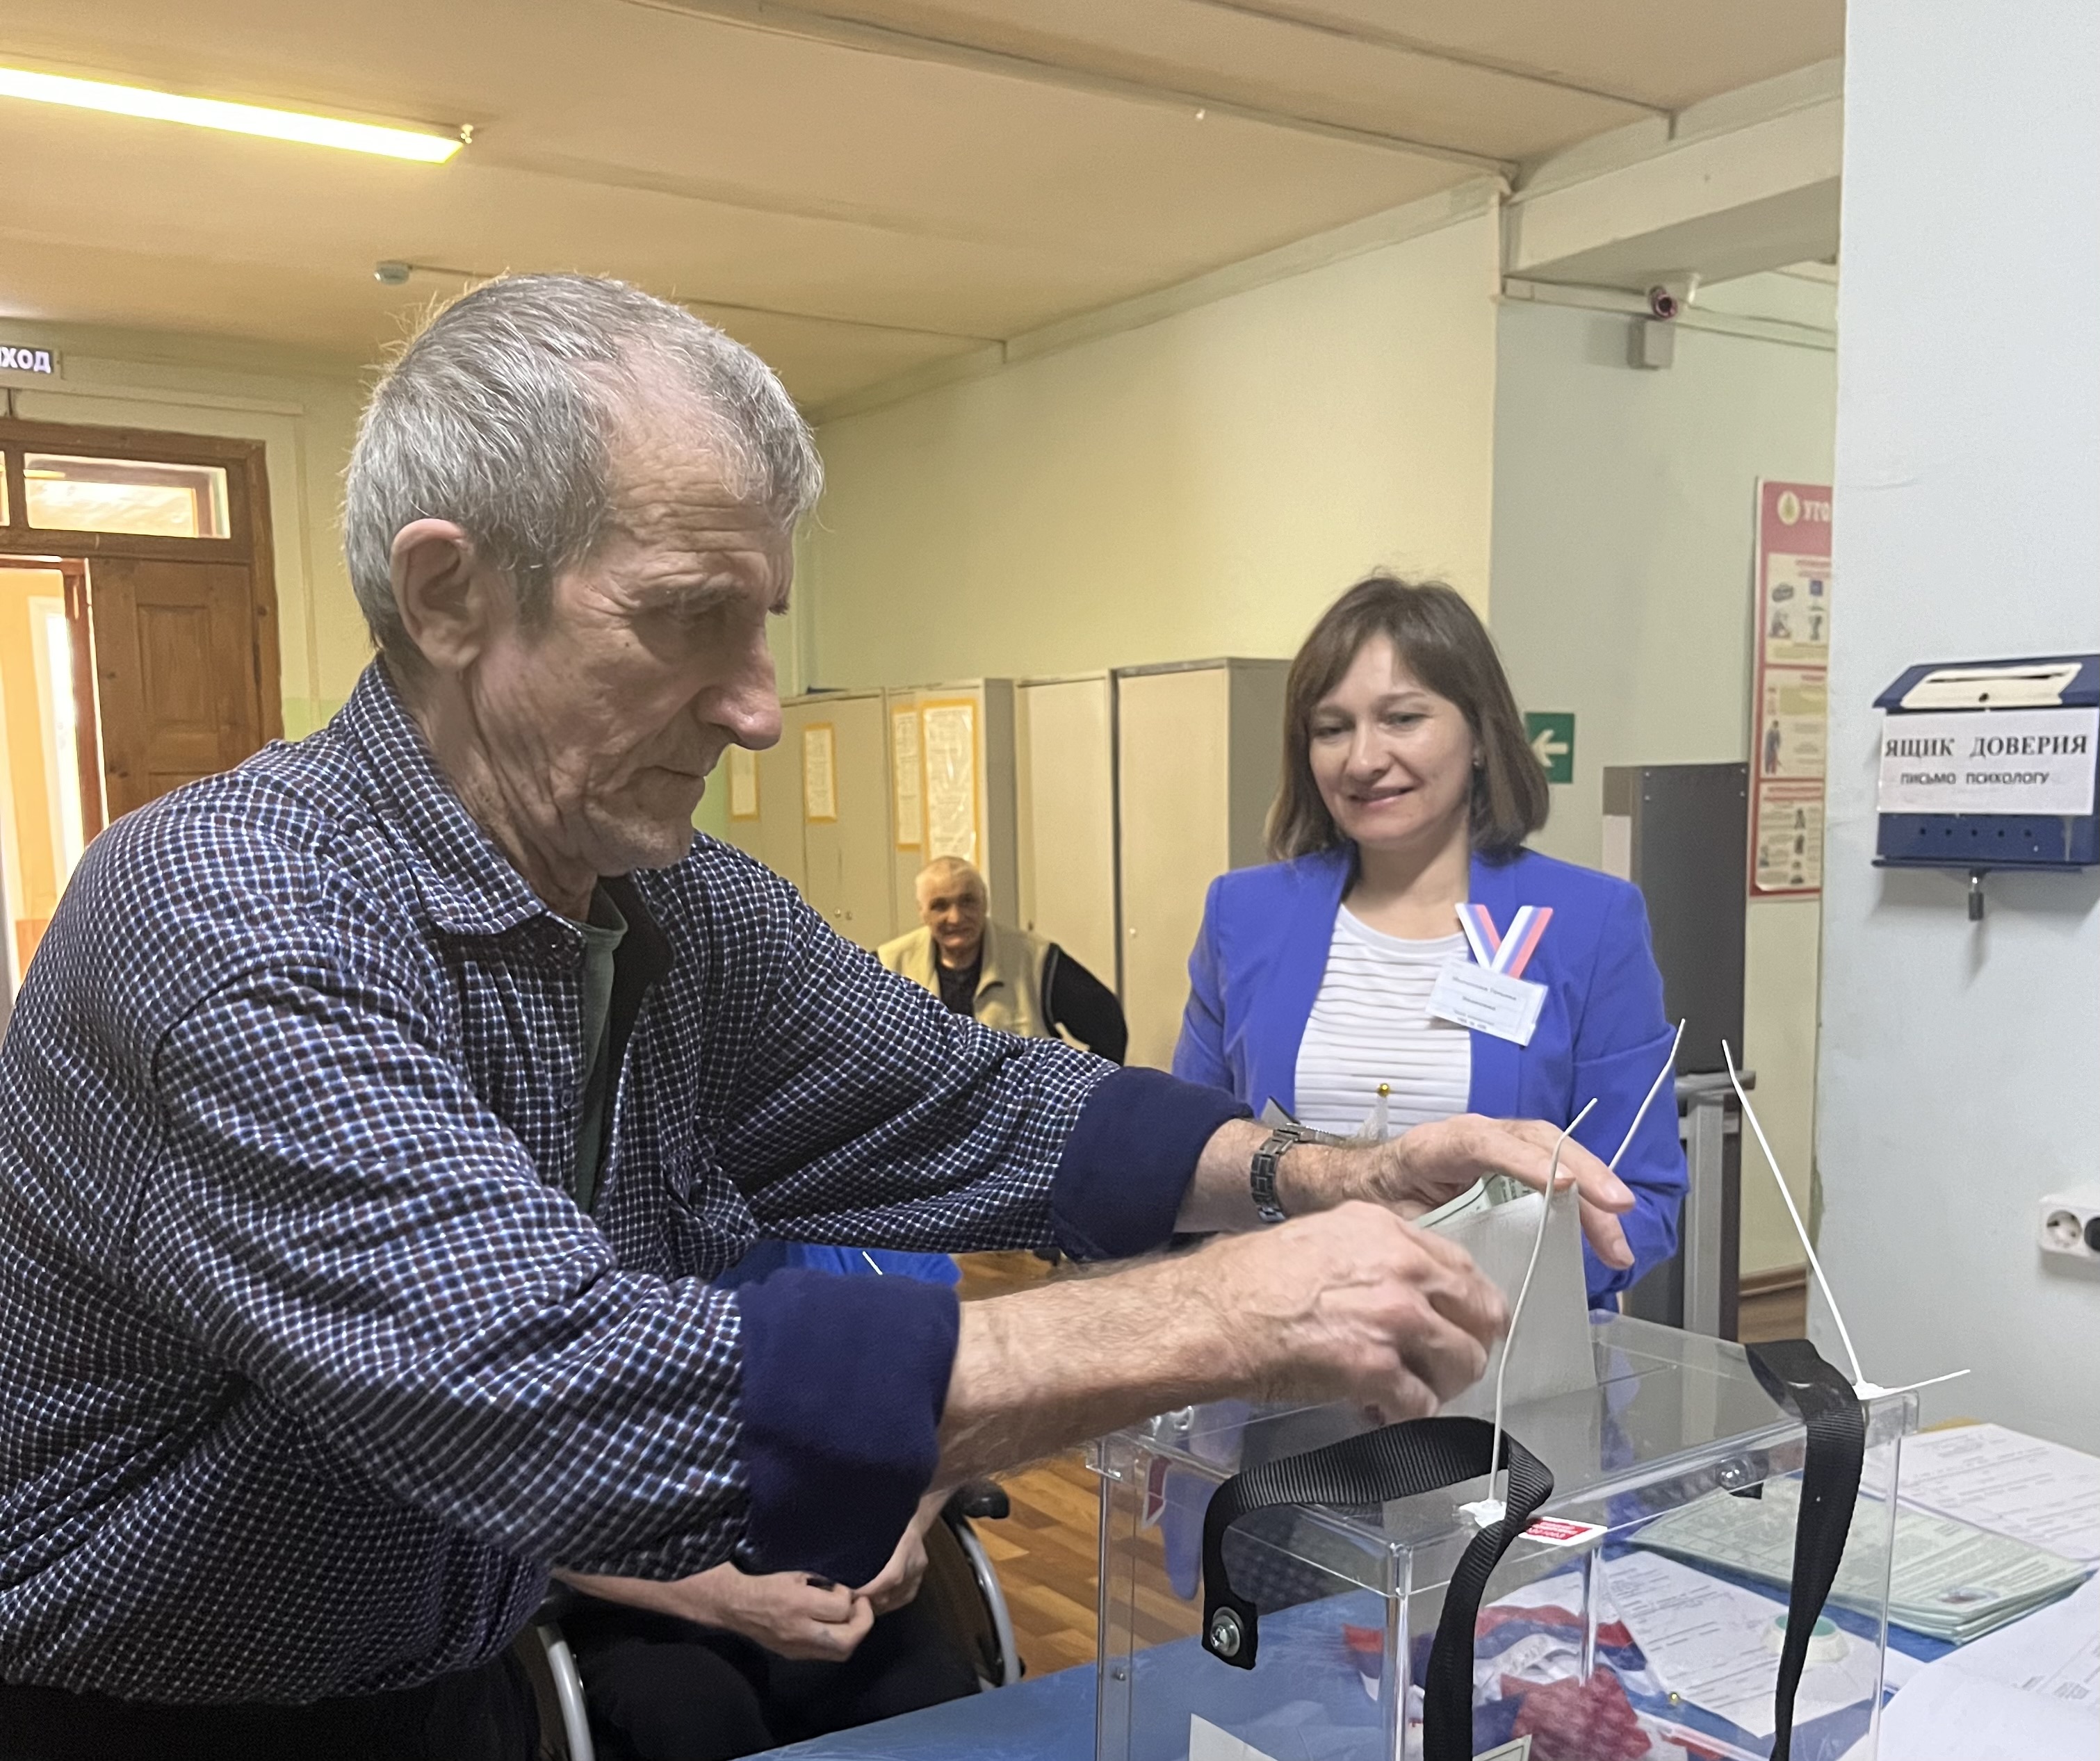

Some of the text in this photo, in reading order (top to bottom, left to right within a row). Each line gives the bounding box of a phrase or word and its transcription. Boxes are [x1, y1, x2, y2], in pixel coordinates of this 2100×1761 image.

[0, 346, 51, 374] ХОД
[1885, 734, 2087, 758] ЯЩИК ДОВЕРИЯ
